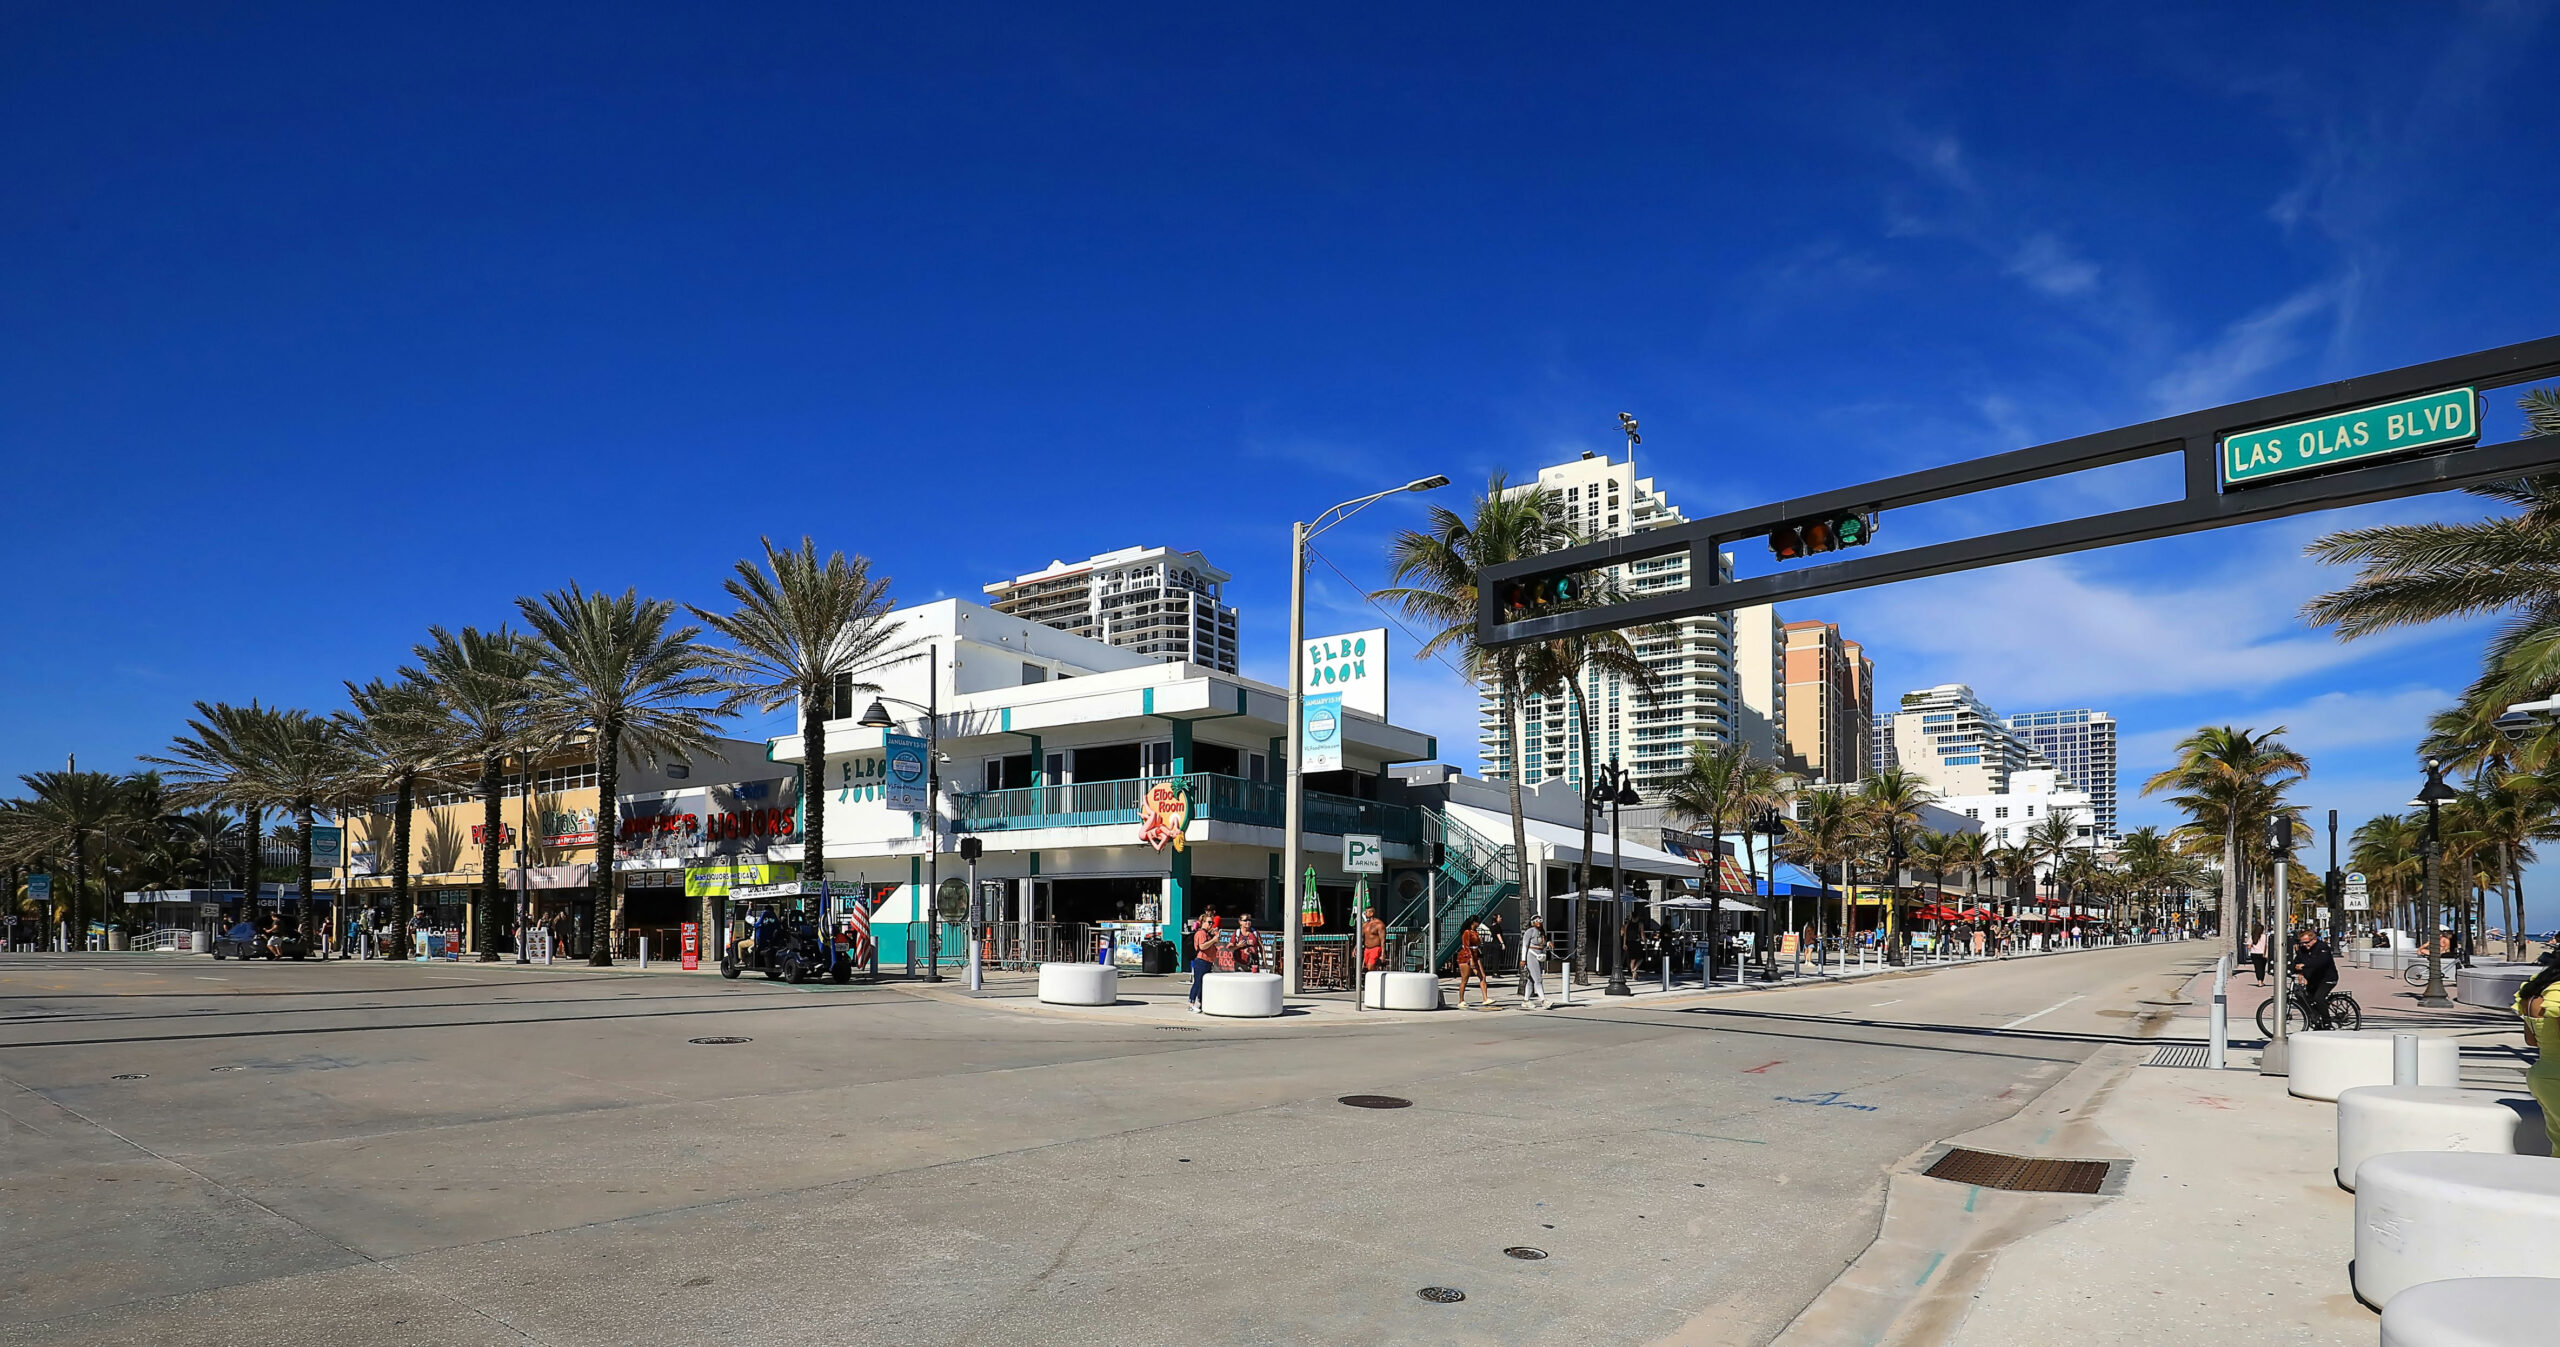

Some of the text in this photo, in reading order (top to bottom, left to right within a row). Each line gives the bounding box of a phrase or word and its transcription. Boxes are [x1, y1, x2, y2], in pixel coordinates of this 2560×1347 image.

[2235, 403, 2462, 472] LAS OLAS BLVD
[1309, 637, 1366, 665] ELBO
[1310, 659, 1366, 687] ROOM
[888, 738, 913, 747] JANUARY
[842, 757, 886, 782] ELBO
[1153, 788, 1174, 802] Elbo
[1158, 801, 1185, 812] Room
[541, 809, 579, 836] Rita's
[707, 807, 794, 841] LIQUORS
[1120, 936, 1141, 946] RUM
